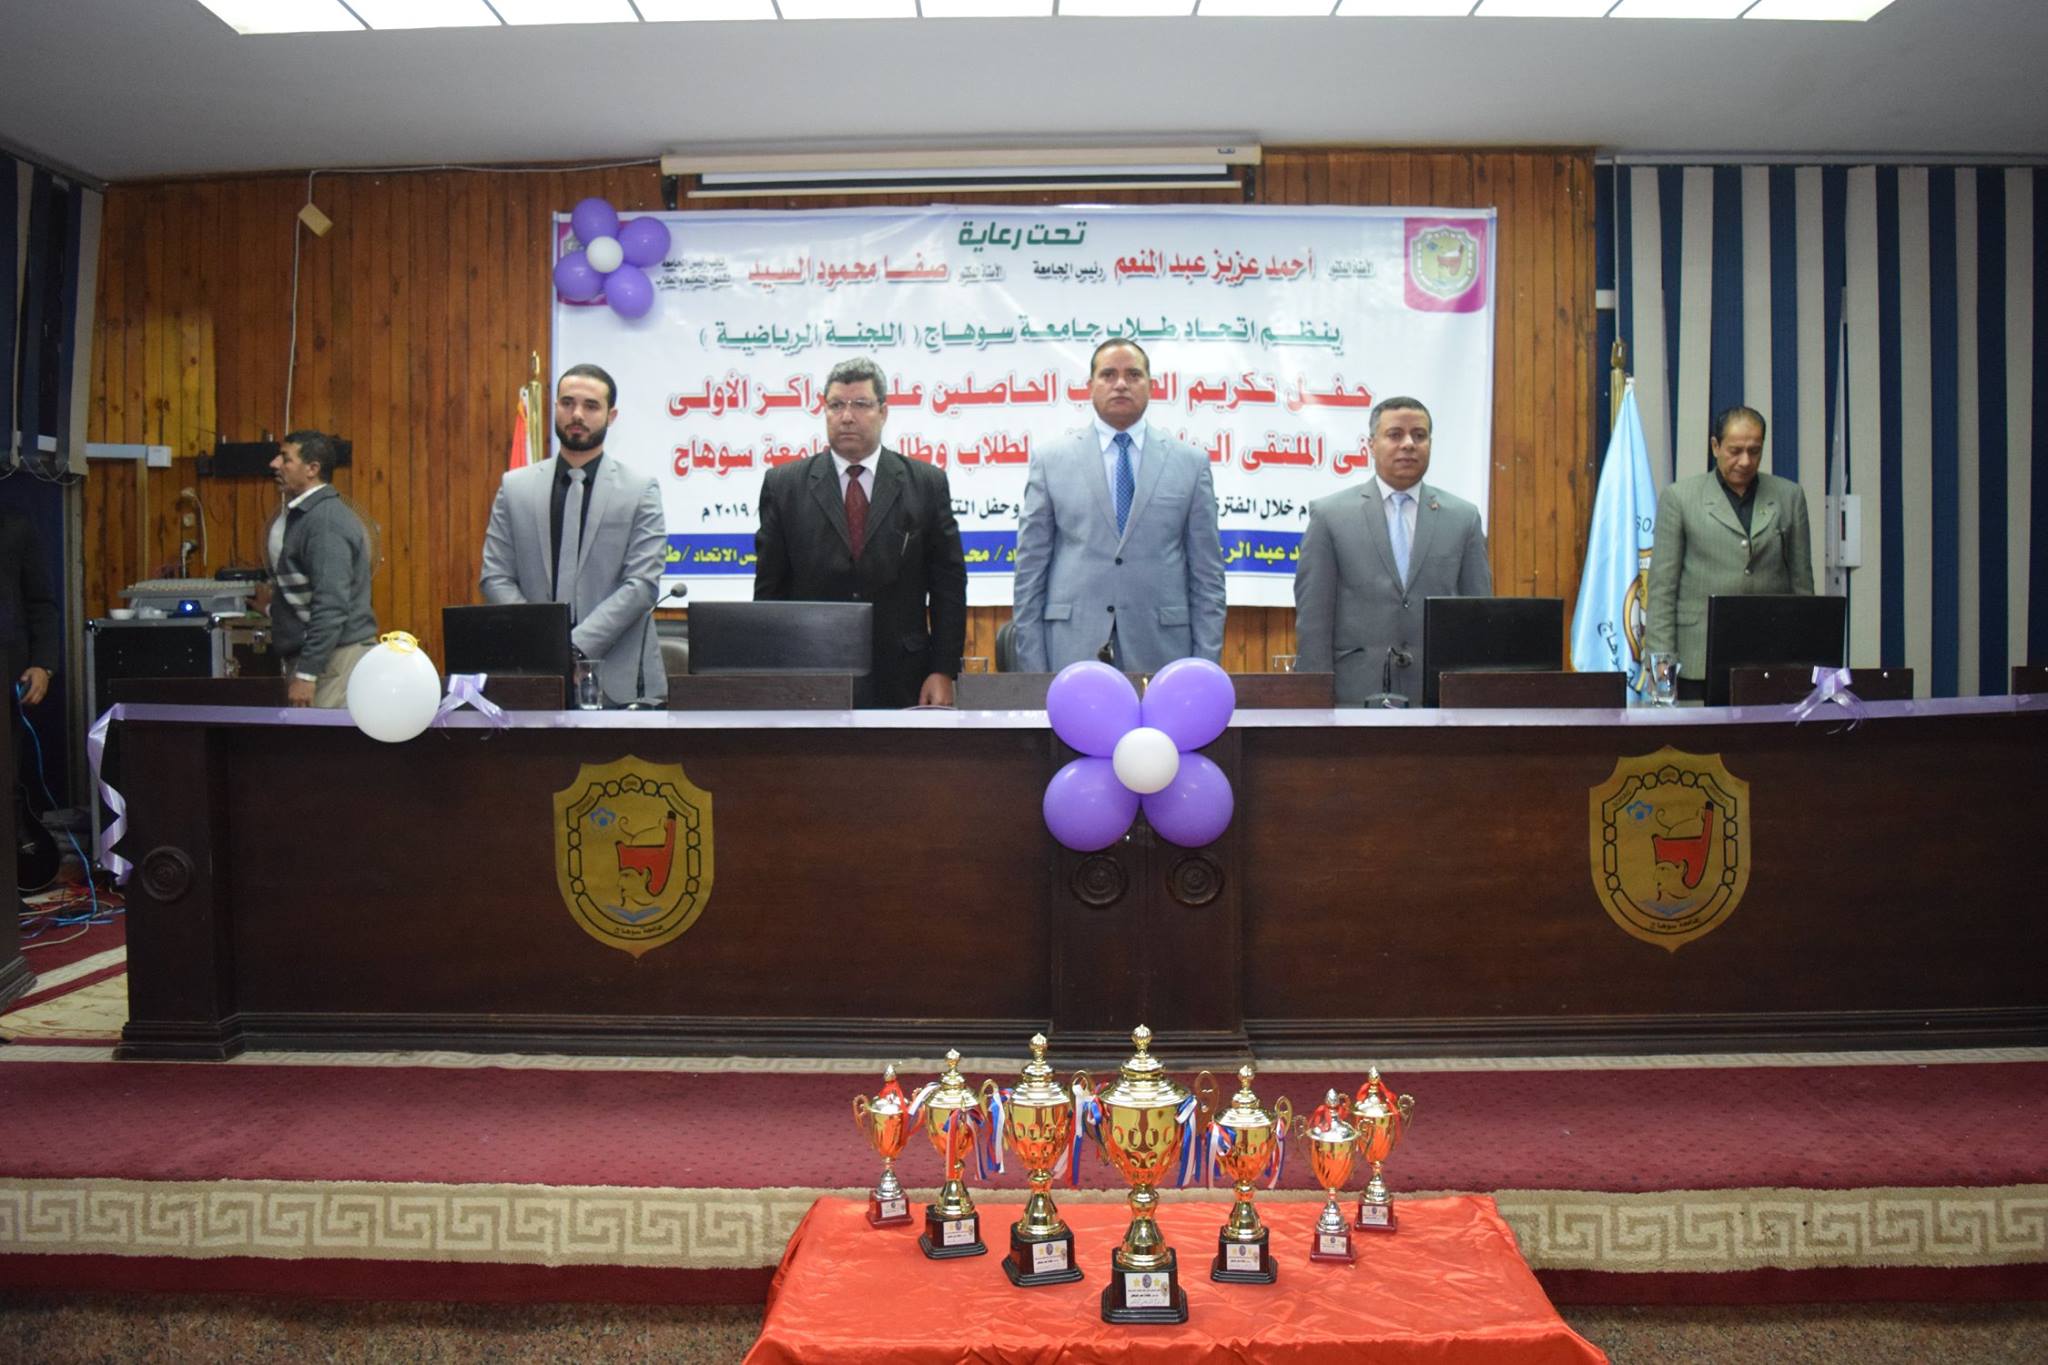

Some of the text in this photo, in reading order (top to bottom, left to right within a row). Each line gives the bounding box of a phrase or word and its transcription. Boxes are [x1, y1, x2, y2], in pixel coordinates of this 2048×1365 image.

[957, 220, 1088, 253] تحت رعاية
[748, 256, 811, 288] السيد
[816, 260, 877, 288] محمود
[884, 251, 949, 279] صفا
[1033, 260, 1073, 279] الجامعة
[1075, 260, 1104, 280] رئيس
[1113, 248, 1164, 280] المنعم
[1168, 252, 1206, 280] عبد
[1210, 248, 1259, 283] عزيز
[1264, 246, 1313, 276] أحمد
[924, 321, 1015, 348] سوهاج
[1019, 313, 1101, 344] جامعة
[1105, 316, 1177, 341] طلاب
[1183, 317, 1254, 341] اتحاد
[1259, 321, 1345, 357] ينظم
[668, 370, 749, 417] الأولى
[754, 375, 826, 417] راكز
[885, 376, 923, 406] عل
[930, 371, 1057, 415] الحاصلين
[1187, 371, 1277, 412] تكريم
[1286, 375, 1373, 411] حفل
[671, 439, 753, 477] سوهاج
[762, 438, 829, 468] امعة
[1241, 431, 1324, 470] الملتقى
[978, 497, 1020, 519] وحفل
[1260, 497, 1294, 520] خلال
[693, 546, 738, 563] الاتحاد
[1253, 543, 1286, 566] عبد
